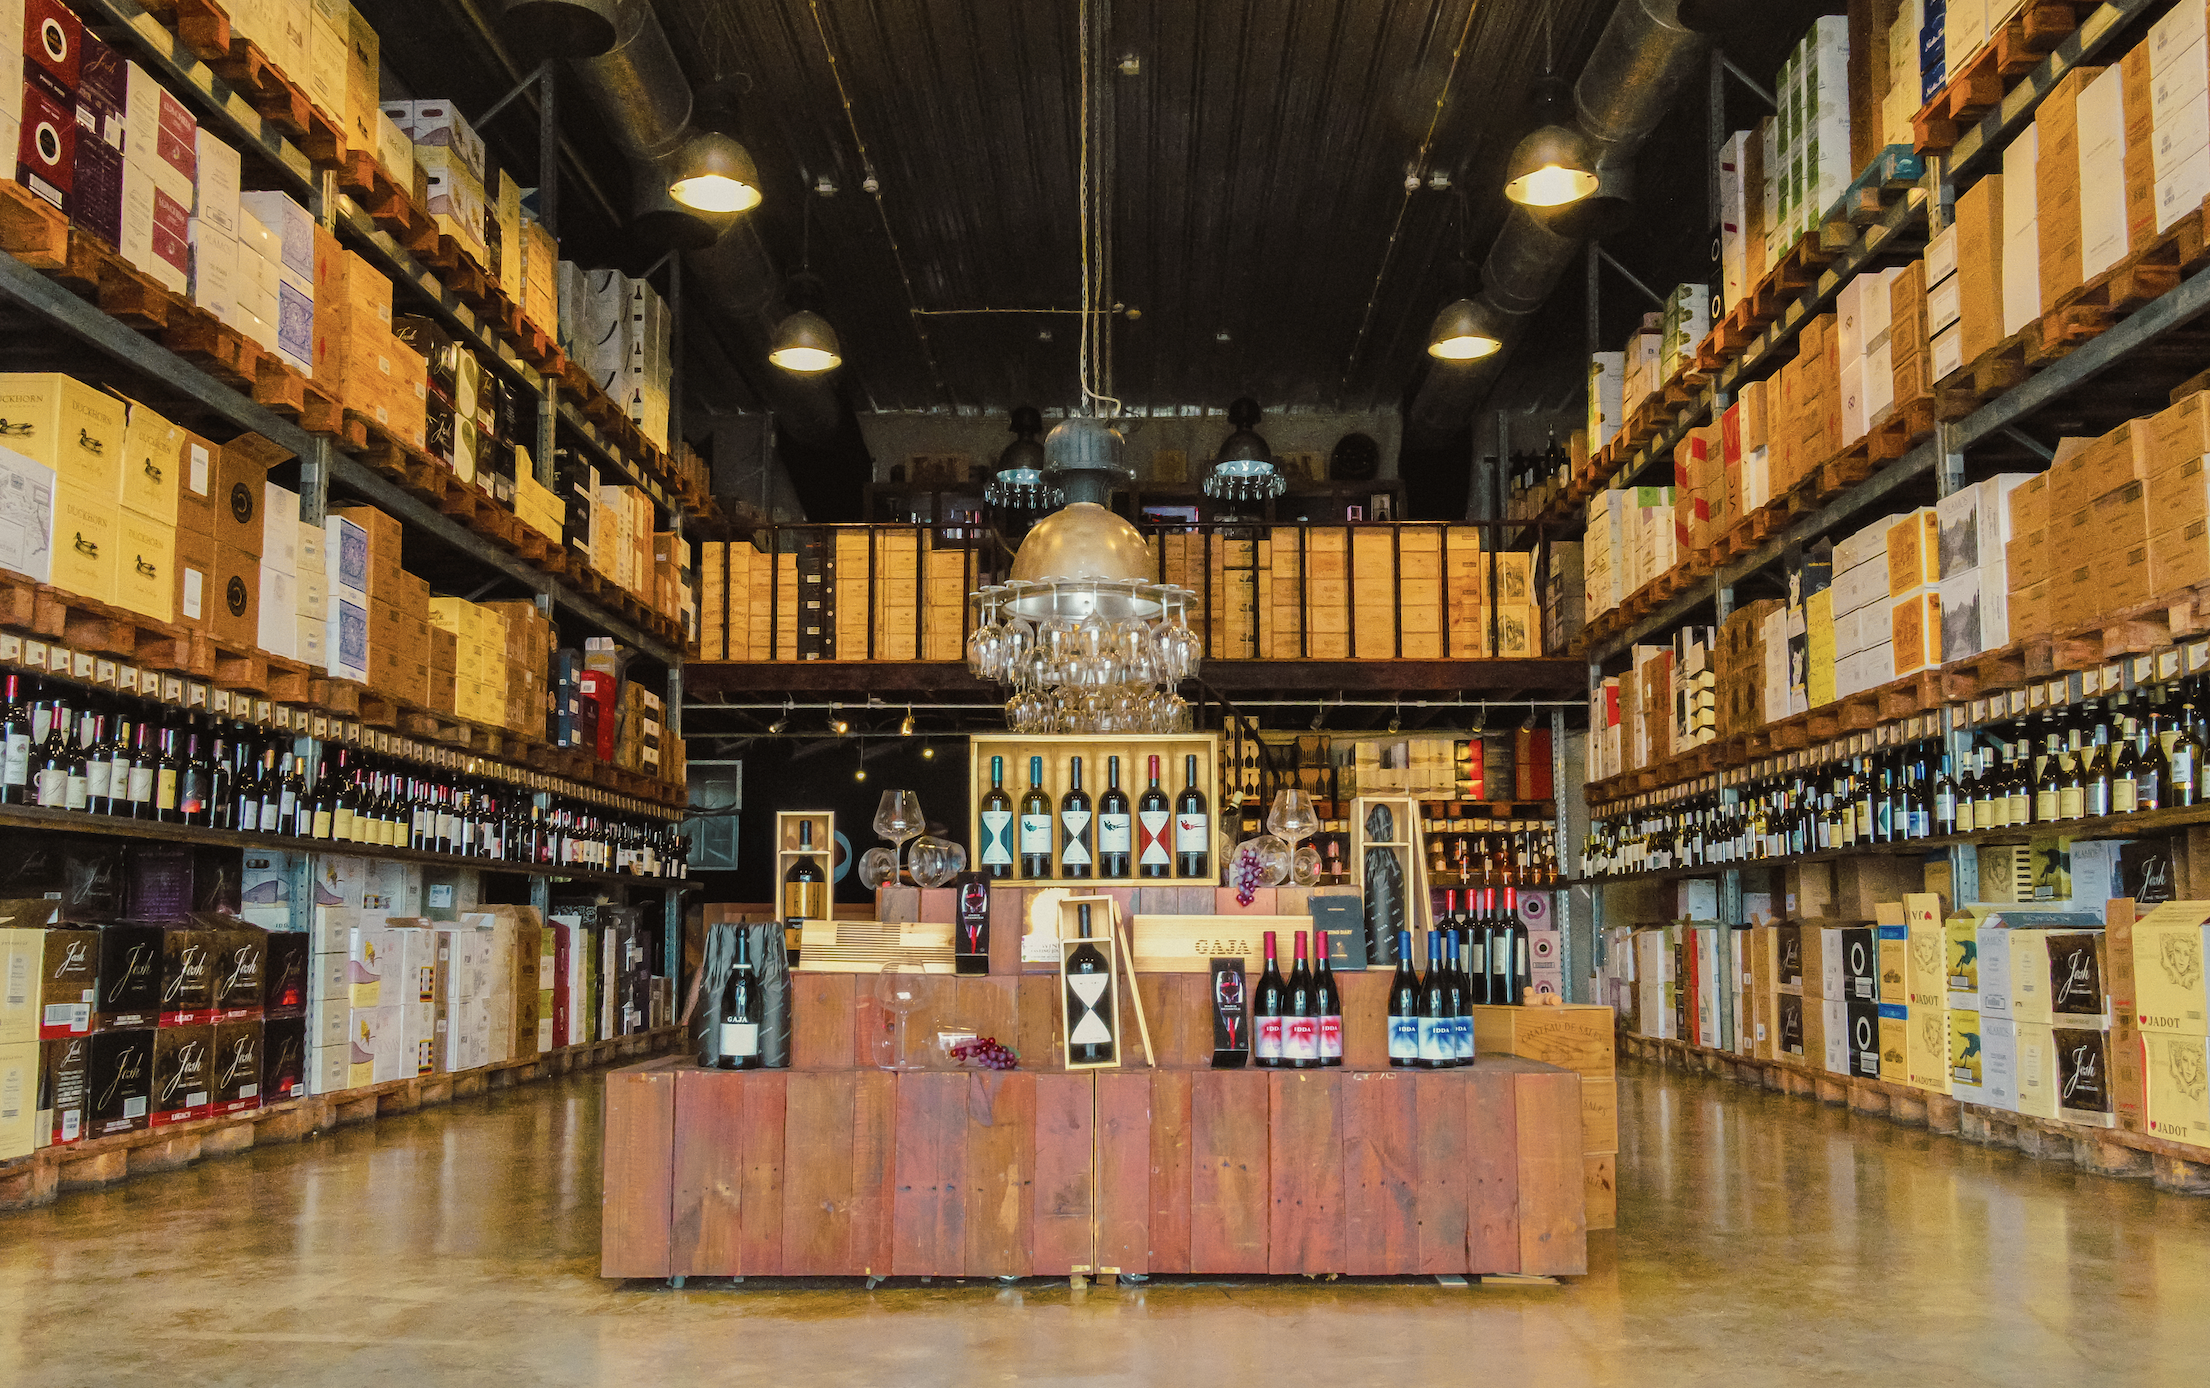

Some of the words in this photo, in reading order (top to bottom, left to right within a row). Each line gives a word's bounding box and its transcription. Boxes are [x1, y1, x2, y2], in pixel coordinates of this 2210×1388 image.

[0, 395, 43, 403] CKHORN
[72, 400, 112, 426] DUCKHORN
[67, 504, 108, 528] DUCKHORN
[2136, 855, 2167, 903] Josh
[54, 940, 87, 978] Josh
[1195, 939, 1252, 955] GAJA
[108, 942, 154, 1004] Josh
[164, 944, 207, 1002] Josh
[219, 944, 260, 1000] Josh
[2058, 948, 2091, 1005] Josh
[1915, 995, 1939, 1007] JADOT
[2148, 1015, 2180, 1028] JADOT
[1521, 1022, 1562, 1043] CHATEAU
[1564, 1022, 1576, 1032] DE
[1579, 1025, 1603, 1042] SALES
[98, 1046, 144, 1111] Josh
[161, 1041, 205, 1102] Josh
[220, 1034, 256, 1090] Josh
[2064, 1045, 2096, 1099] Josh
[2158, 1122, 2188, 1137] JADOT
